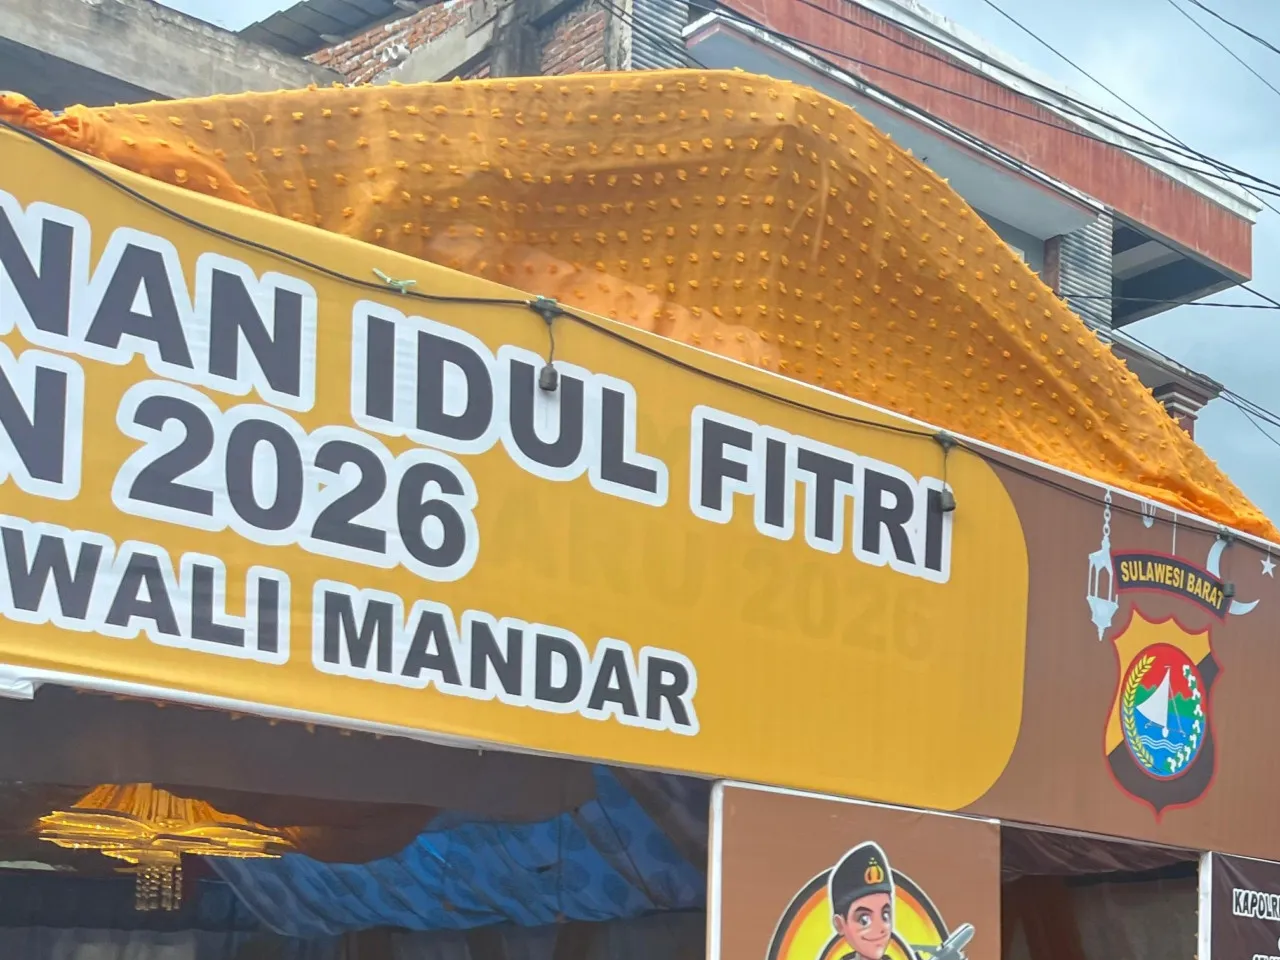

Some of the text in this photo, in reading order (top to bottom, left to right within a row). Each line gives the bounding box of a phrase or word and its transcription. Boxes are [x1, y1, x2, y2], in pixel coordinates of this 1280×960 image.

[128, 394, 467, 568] 2026
[366, 315, 658, 494] IDUL
[700, 418, 946, 574] FITRI
[1, 526, 692, 725] WALI MANDAR
[1120, 561, 1224, 610] SULAWESI BARAT
